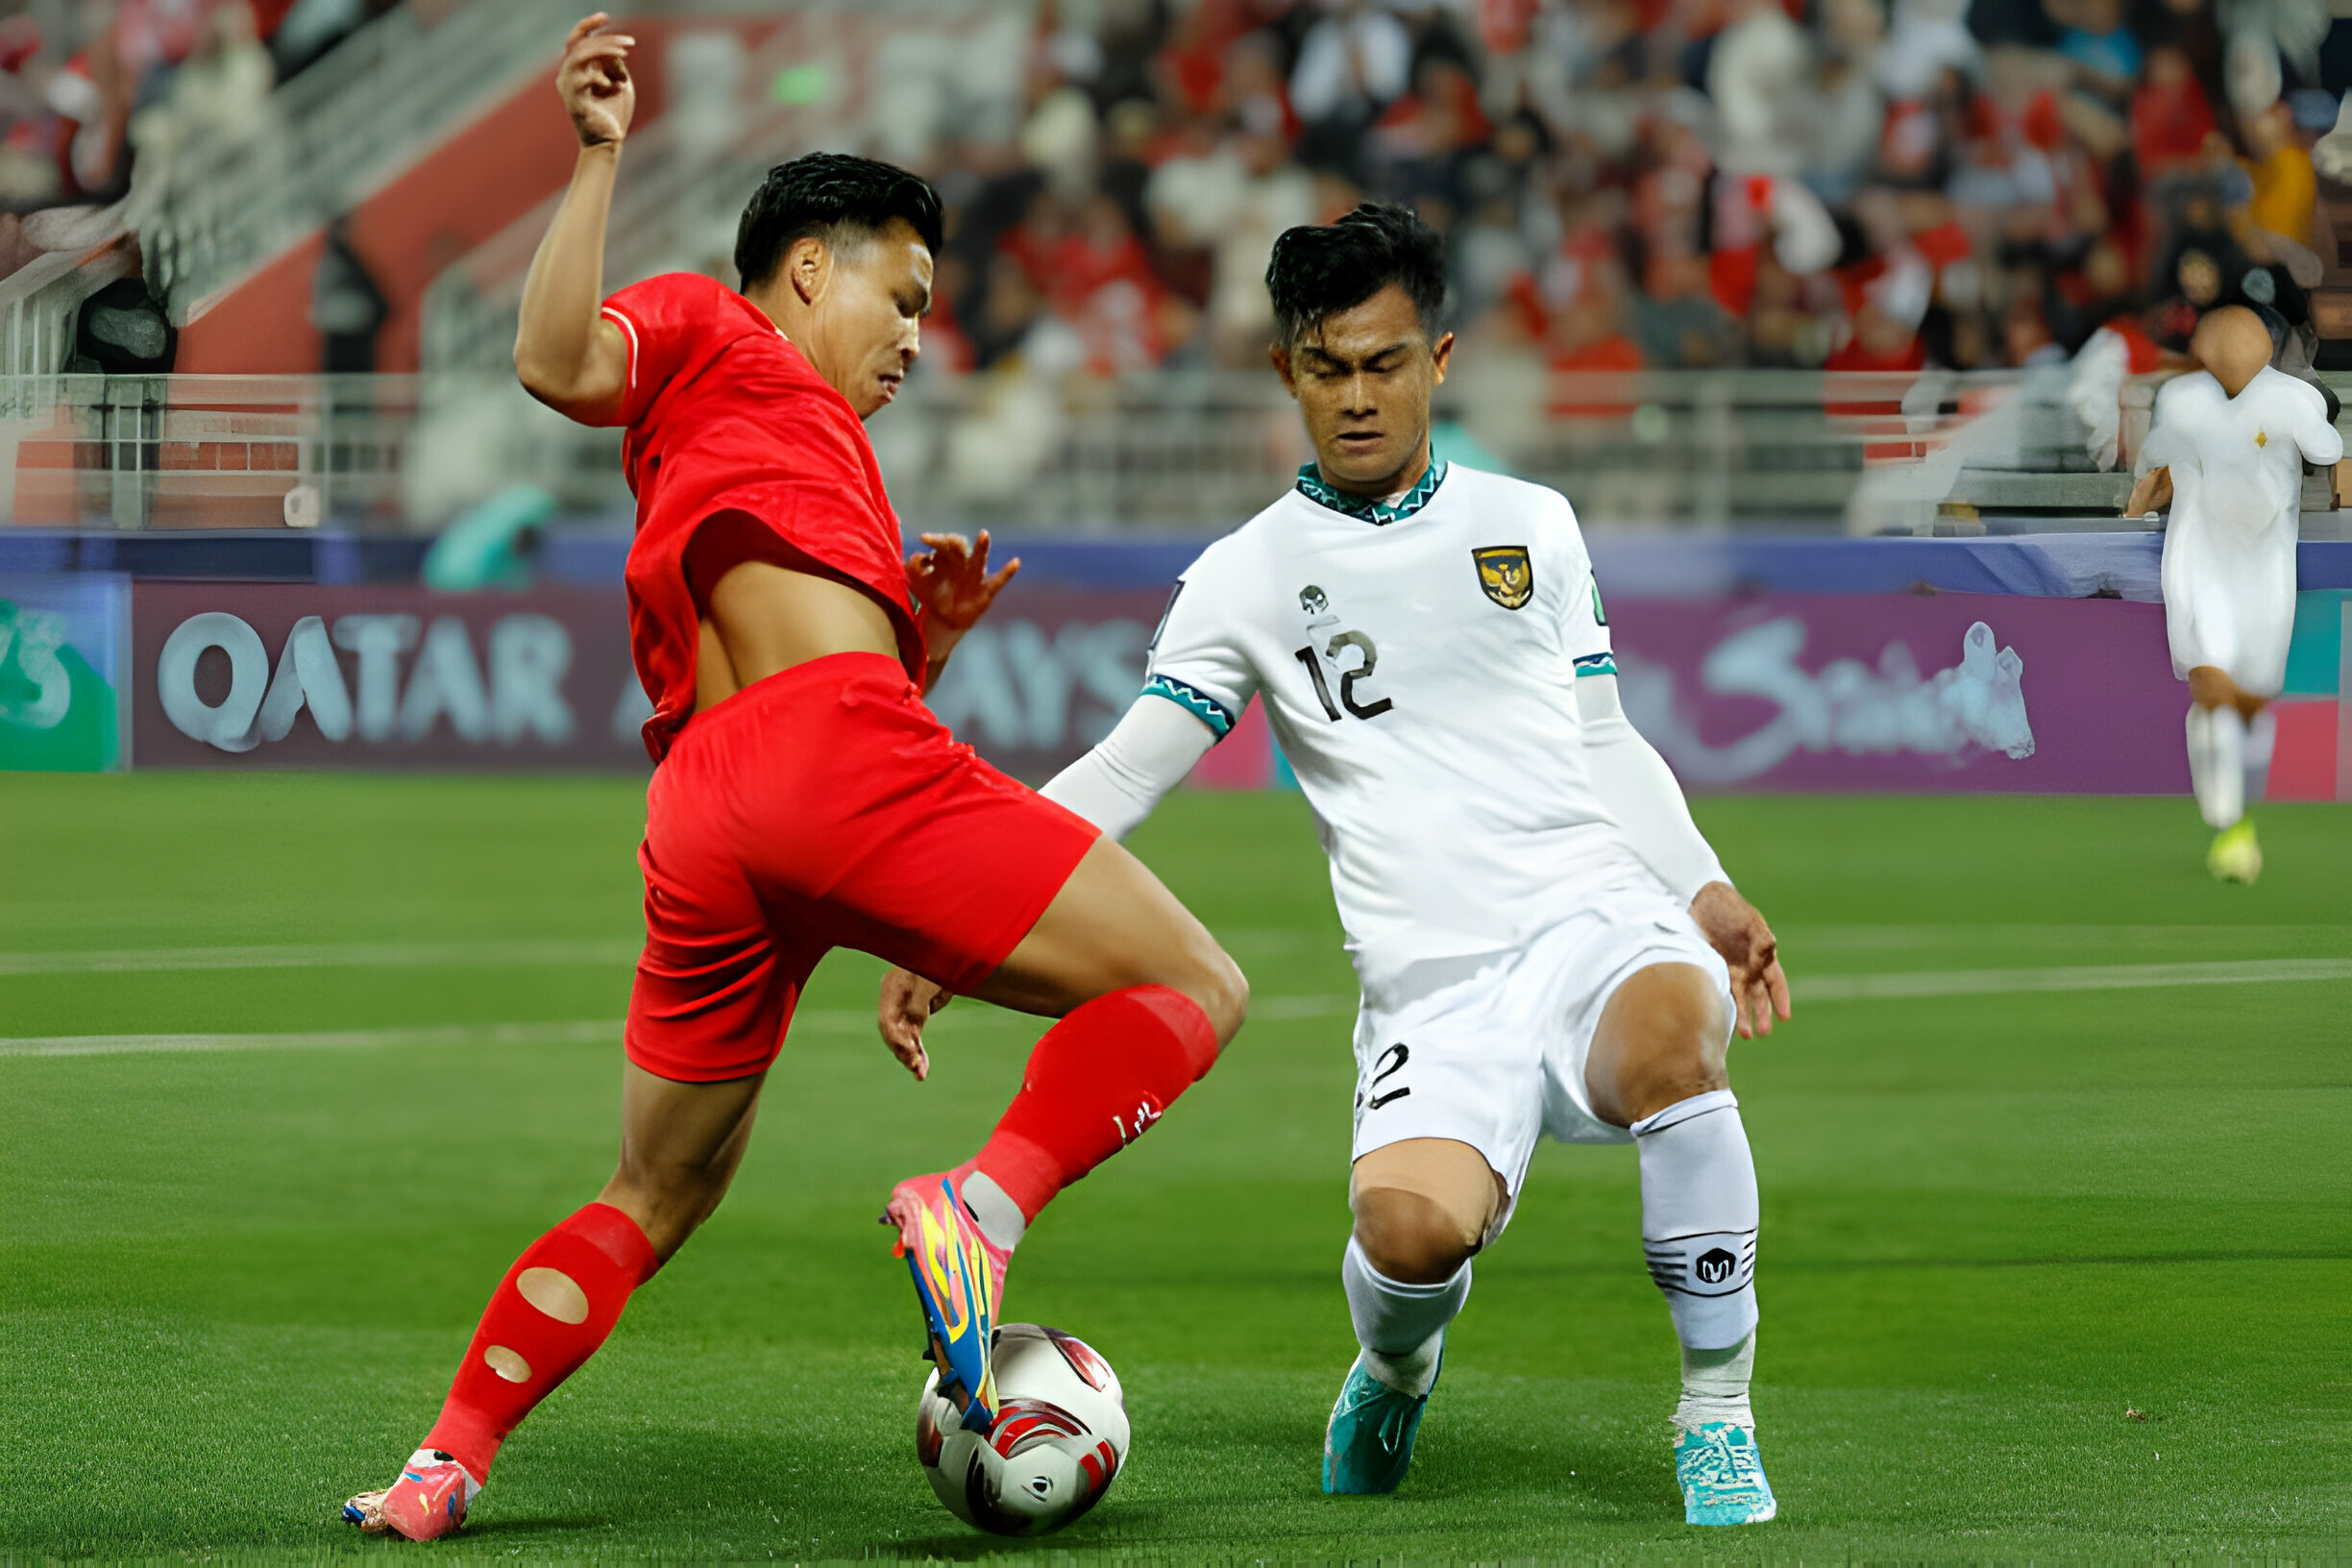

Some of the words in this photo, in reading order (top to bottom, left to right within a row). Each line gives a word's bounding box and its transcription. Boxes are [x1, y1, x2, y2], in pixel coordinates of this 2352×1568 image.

[157, 611, 576, 753] QATAR
[1294, 629, 1394, 722] 12
[1357, 1041, 1411, 1111] 2
